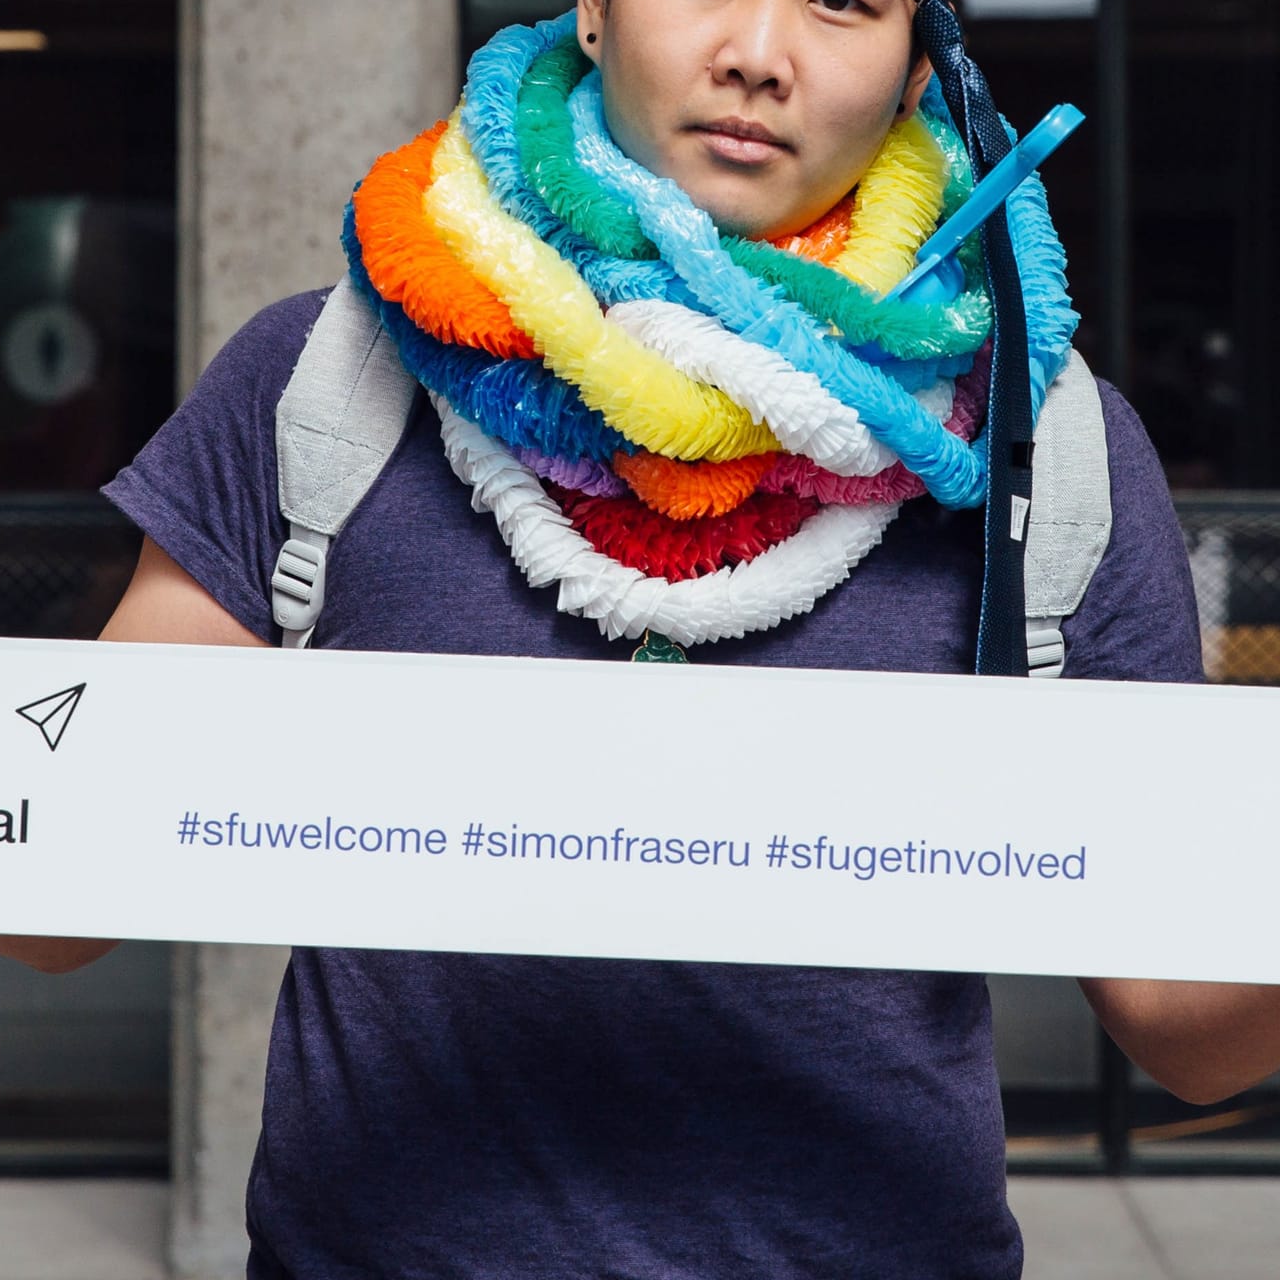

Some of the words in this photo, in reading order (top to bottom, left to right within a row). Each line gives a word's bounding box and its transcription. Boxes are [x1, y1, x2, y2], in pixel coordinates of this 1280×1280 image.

[177, 811, 447, 855] #sfuwelcome
[461, 822, 750, 867] #simonfraseru
[765, 834, 1086, 881] #sfugetinvolved
